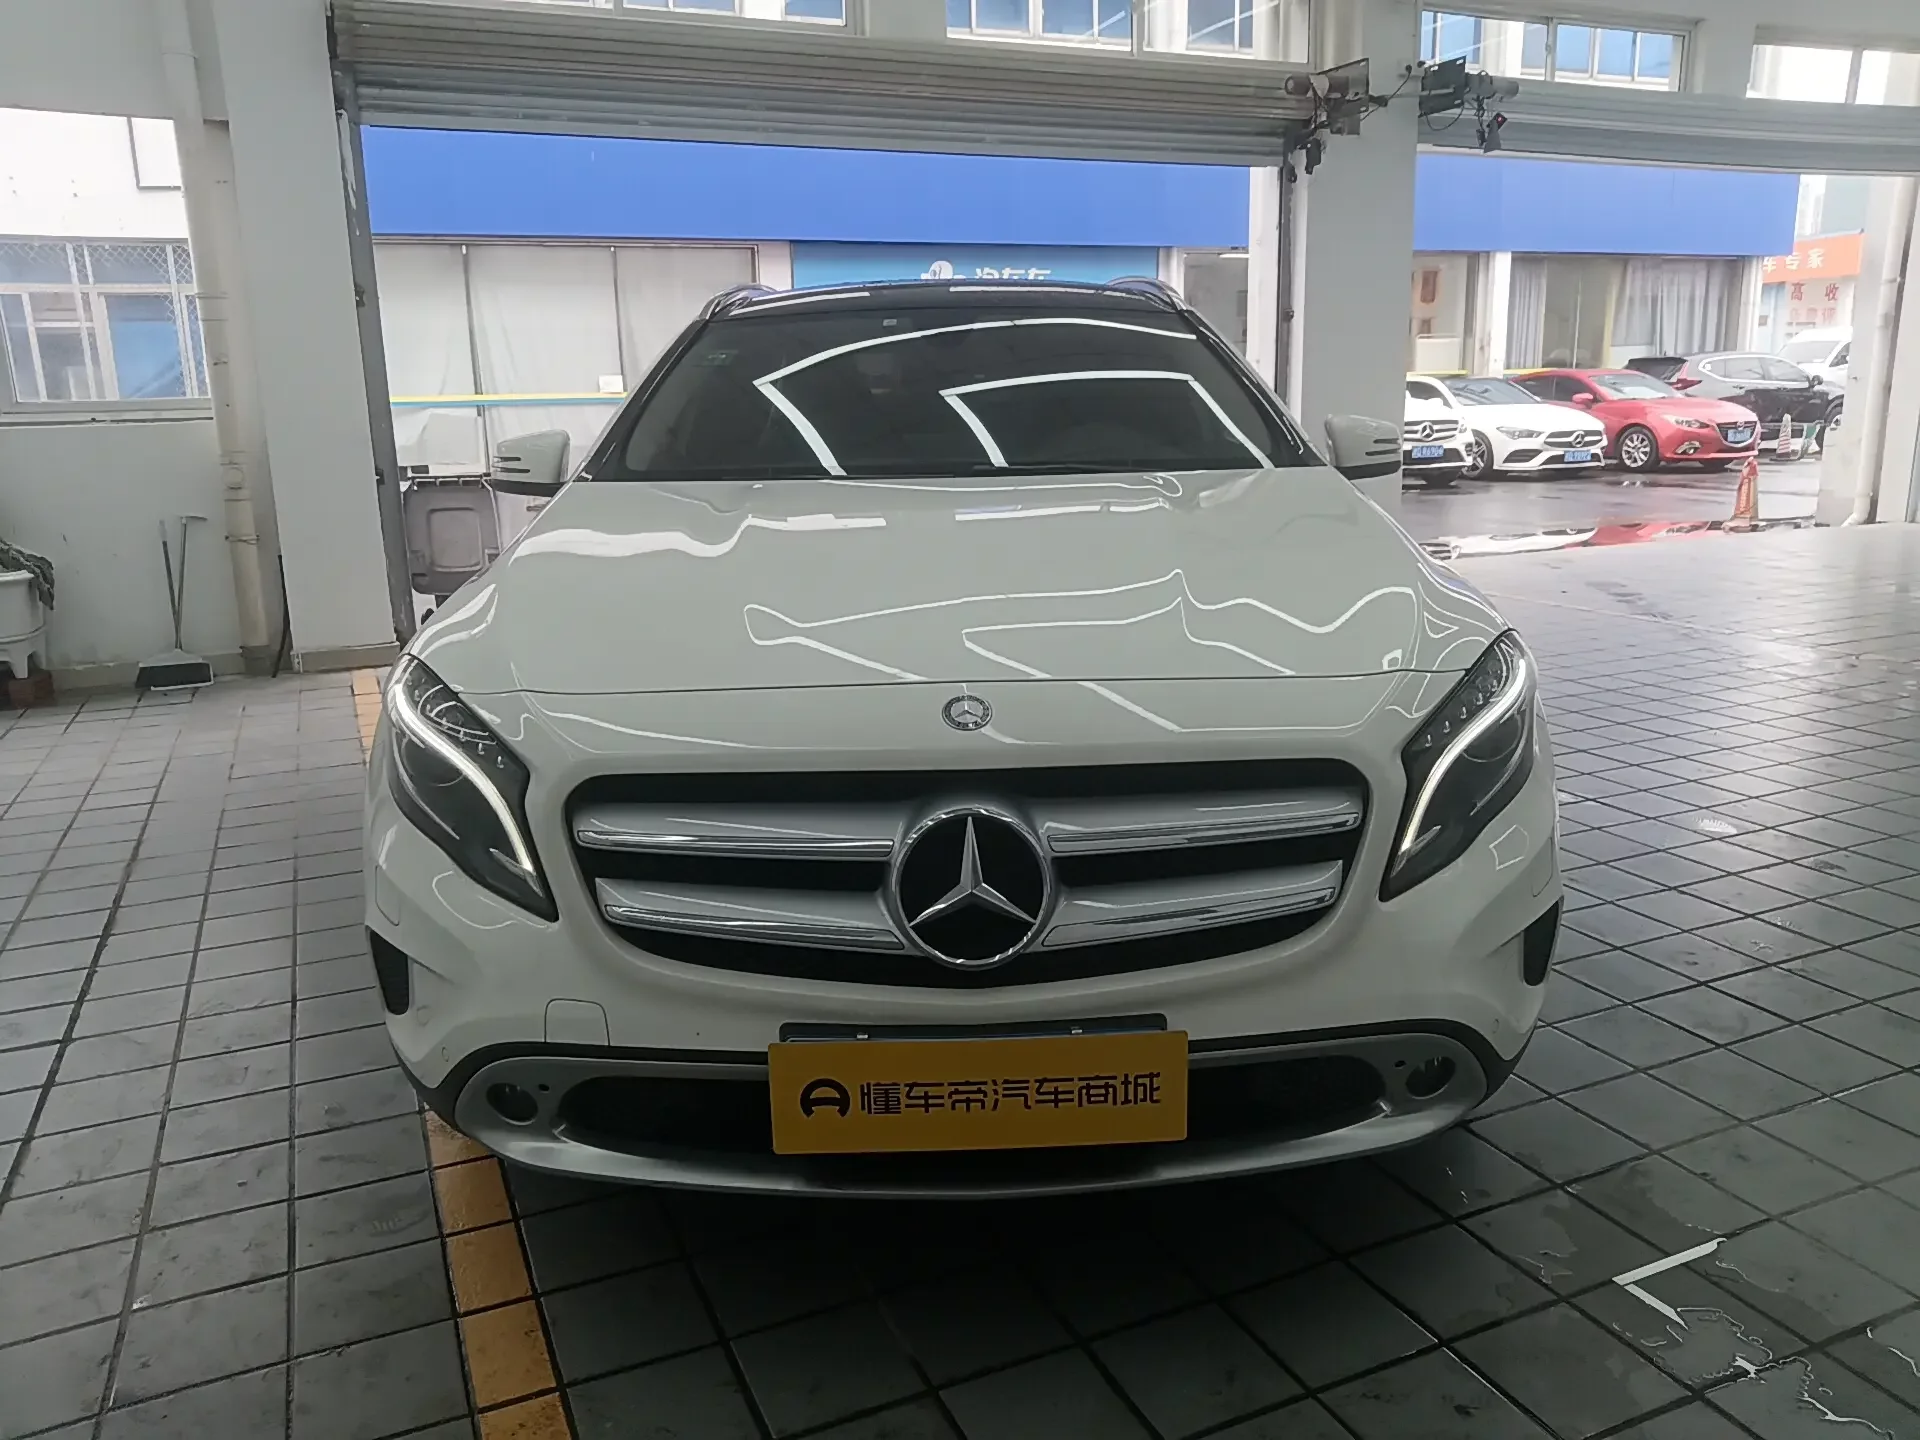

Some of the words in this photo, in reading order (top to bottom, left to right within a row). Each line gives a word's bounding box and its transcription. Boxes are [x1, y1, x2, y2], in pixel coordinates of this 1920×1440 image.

[859, 1072, 1162, 1115] 懂车帝汽车商城
